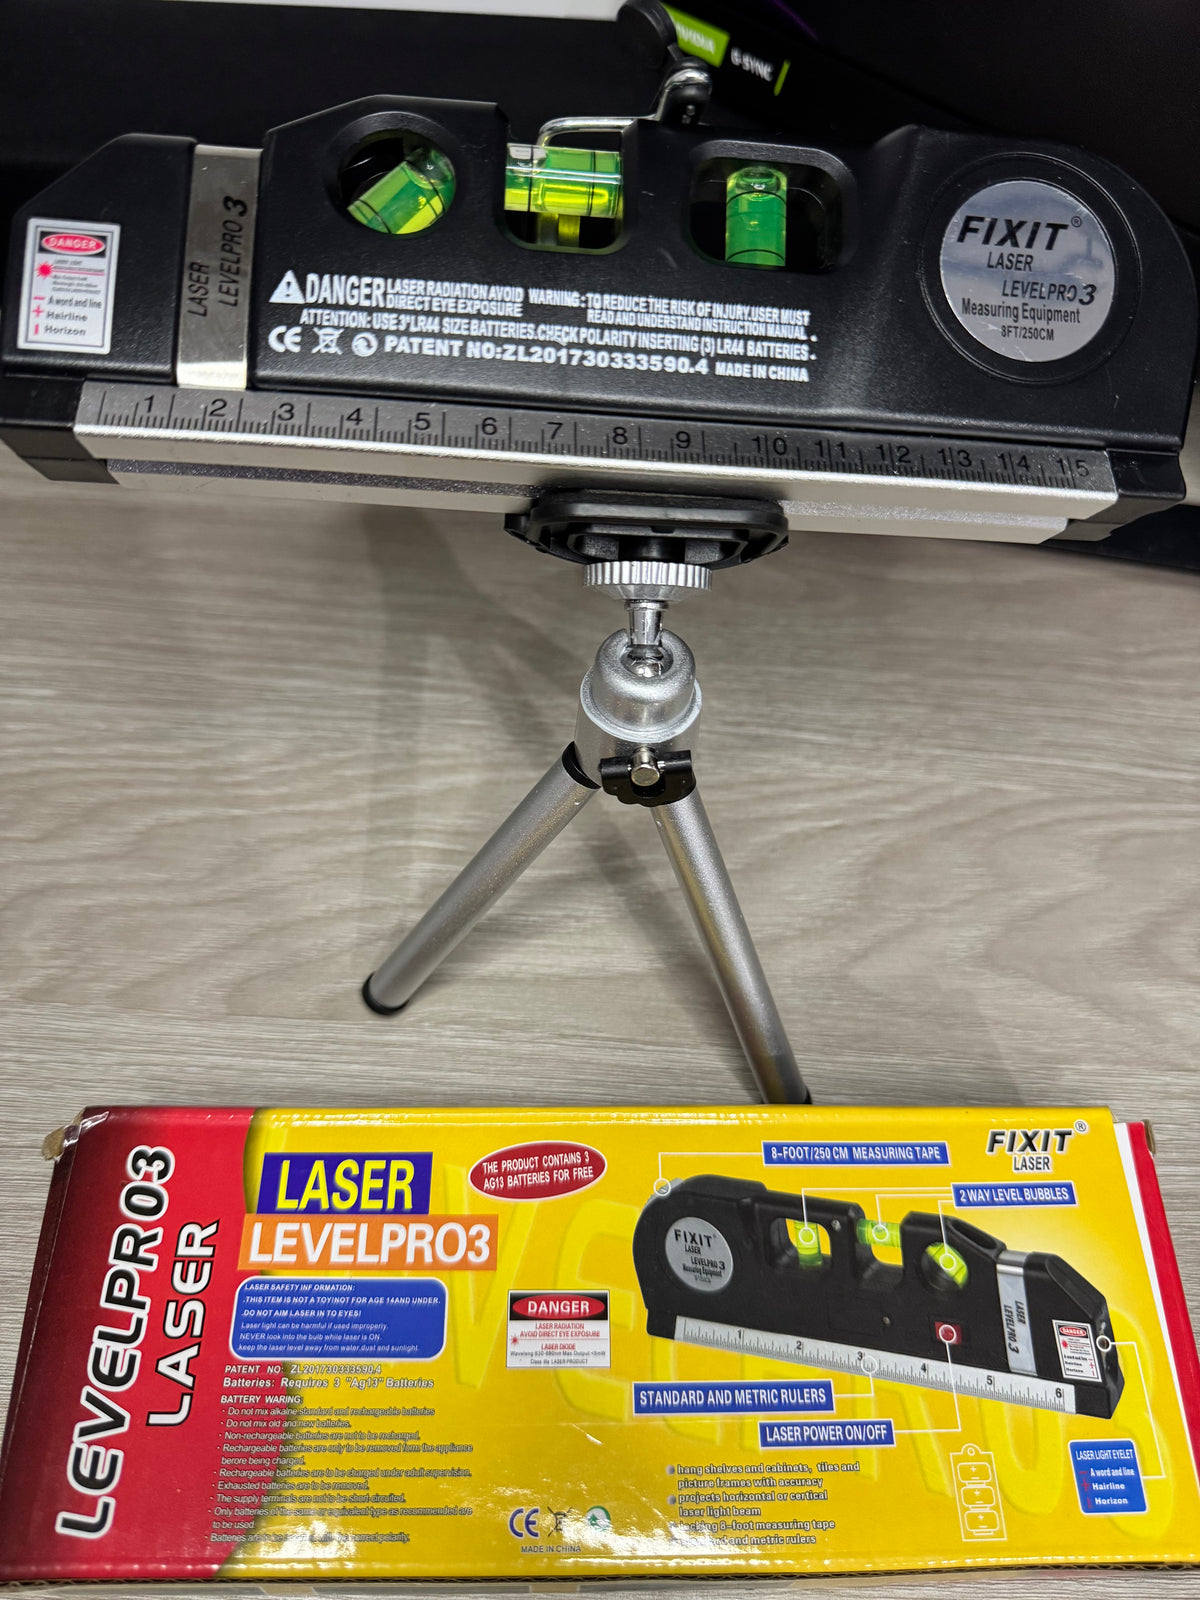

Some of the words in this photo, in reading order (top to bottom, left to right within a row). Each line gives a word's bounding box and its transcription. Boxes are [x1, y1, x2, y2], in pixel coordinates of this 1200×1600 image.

[222, 195, 248, 217] 3
[957, 215, 1069, 251] FIXIT
[48, 237, 97, 249] DANGER
[217, 220, 244, 308] LEVELPRO
[986, 251, 1034, 272] LASER
[187, 261, 210, 318] LASER
[306, 272, 386, 308] DANGER
[387, 278, 426, 296] LASER
[426, 280, 489, 300] RADIATION
[488, 284, 524, 302] AVOID
[1002, 280, 1077, 302] LEVELPRO
[1078, 283, 1098, 306] 3
[386, 294, 430, 312] DIRECT
[431, 297, 456, 313] EYE
[457, 299, 523, 318] EXPOSURE
[586, 292, 602, 309] TO
[602, 294, 648, 312] REDUCE
[648, 296, 670, 314] THE
[670, 299, 696, 316] RISK
[696, 300, 712, 317] OF
[780, 308, 810, 326] MUST
[962, 297, 1019, 324] Measuring
[1022, 302, 1080, 324] Equipment
[46, 310, 88, 322] Hairline
[587, 308, 614, 324] READ
[614, 310, 636, 326] AND
[637, 312, 701, 331] UNDERSTAND
[702, 317, 766, 336] INSTRUCTION
[44, 324, 86, 336] Horizon
[299, 308, 371, 329] ATTENTION:
[372, 312, 398, 330] USE
[442, 316, 470, 335] SIZE
[580, 327, 638, 348] POLARITY
[638, 330, 699, 352] INSERTING
[700, 336, 715, 357] (3)
[716, 338, 744, 356] LR44
[1001, 324, 1054, 341] 8FT/250CM
[384, 334, 463, 357] PATENT
[715, 360, 752, 378] MADE
[752, 364, 767, 380] IN
[768, 365, 809, 383] CHINA
[144, 396, 154, 414] 1
[208, 398, 228, 418] 2
[277, 402, 296, 422] 3
[346, 407, 364, 427] 4
[414, 412, 432, 432] 5
[481, 416, 499, 436] 6
[546, 422, 564, 441] 7
[612, 426, 628, 446] 8
[676, 430, 692, 450] 9
[986, 1129, 1072, 1154] FIXIT
[832, 1146, 848, 1160] CM
[852, 1146, 913, 1160] MEASURING
[916, 1146, 940, 1160] TAPE
[483, 1161, 498, 1174] THE
[502, 1156, 539, 1172] PRODUCT
[542, 1152, 581, 1167] CONTAINS
[584, 1151, 590, 1162] 3
[1013, 1154, 1051, 1172] LASER
[276, 1158, 416, 1211] LASER
[484, 1176, 504, 1190] AG13
[508, 1171, 550, 1187] BATTERIES
[554, 1168, 570, 1181] FOR
[573, 1166, 594, 1178] FREE
[959, 1188, 966, 1202] 2
[967, 1188, 991, 1202] WAY
[992, 1188, 1022, 1201] LEVEL
[1024, 1186, 1069, 1201] BUBBLES
[248, 1220, 490, 1265] LEVELPRO3
[270, 1283, 300, 1291] SAFETY
[528, 1300, 590, 1313] DANGER
[146, 1218, 220, 1428] LASER
[55, 1145, 175, 1539] LEVELPRO3
[224, 1365, 260, 1373] PATENT
[267, 1365, 284, 1373] NO:
[223, 1377, 274, 1387] Batteries:
[280, 1377, 328, 1389] Requires
[334, 1378, 340, 1388] 3
[386, 1378, 434, 1388] Batteries
[220, 1395, 261, 1404] BATTERY
[265, 1395, 303, 1404] WARING:
[640, 1390, 705, 1407] STANDARD
[707, 1390, 732, 1406] AND
[734, 1389, 780, 1405] METRIC
[782, 1388, 826, 1404] RULERS
[766, 1426, 801, 1442] LASER
[803, 1426, 842, 1442] POWER
[845, 1424, 888, 1441] ON/OFF
[1076, 1450, 1094, 1460] LASER
[1095, 1450, 1112, 1460] LIGHT
[1112, 1449, 1134, 1460] EYELET
[677, 1464, 703, 1476] hang
[705, 1463, 743, 1474] shelves
[745, 1462, 764, 1473] and
[766, 1462, 812, 1473] cabinets,
[817, 1462, 839, 1472] tiles
[841, 1461, 860, 1471] and
[1090, 1468, 1096, 1477] A
[1096, 1468, 1111, 1477] word
[1111, 1468, 1122, 1476] and
[1122, 1468, 1134, 1476] line
[678, 1478, 714, 1490] picture
[716, 1477, 751, 1488] frames
[754, 1477, 776, 1487] with
[778, 1478, 823, 1488] accuracy
[1092, 1482, 1125, 1490] Hairline
[678, 1492, 720, 1504] projects
[722, 1491, 775, 1502] horizontal
[777, 1493, 788, 1501] or
[790, 1490, 828, 1500] certical
[1095, 1497, 1128, 1505] Horizon
[679, 1506, 704, 1516] laser
[706, 1506, 730, 1518] light
[732, 1506, 761, 1516] beam
[756, 1519, 810, 1530] measuring
[812, 1520, 835, 1530] tape
[729, 1535, 748, 1545] and
[750, 1534, 784, 1544] metric
[786, 1533, 816, 1544] rulers
